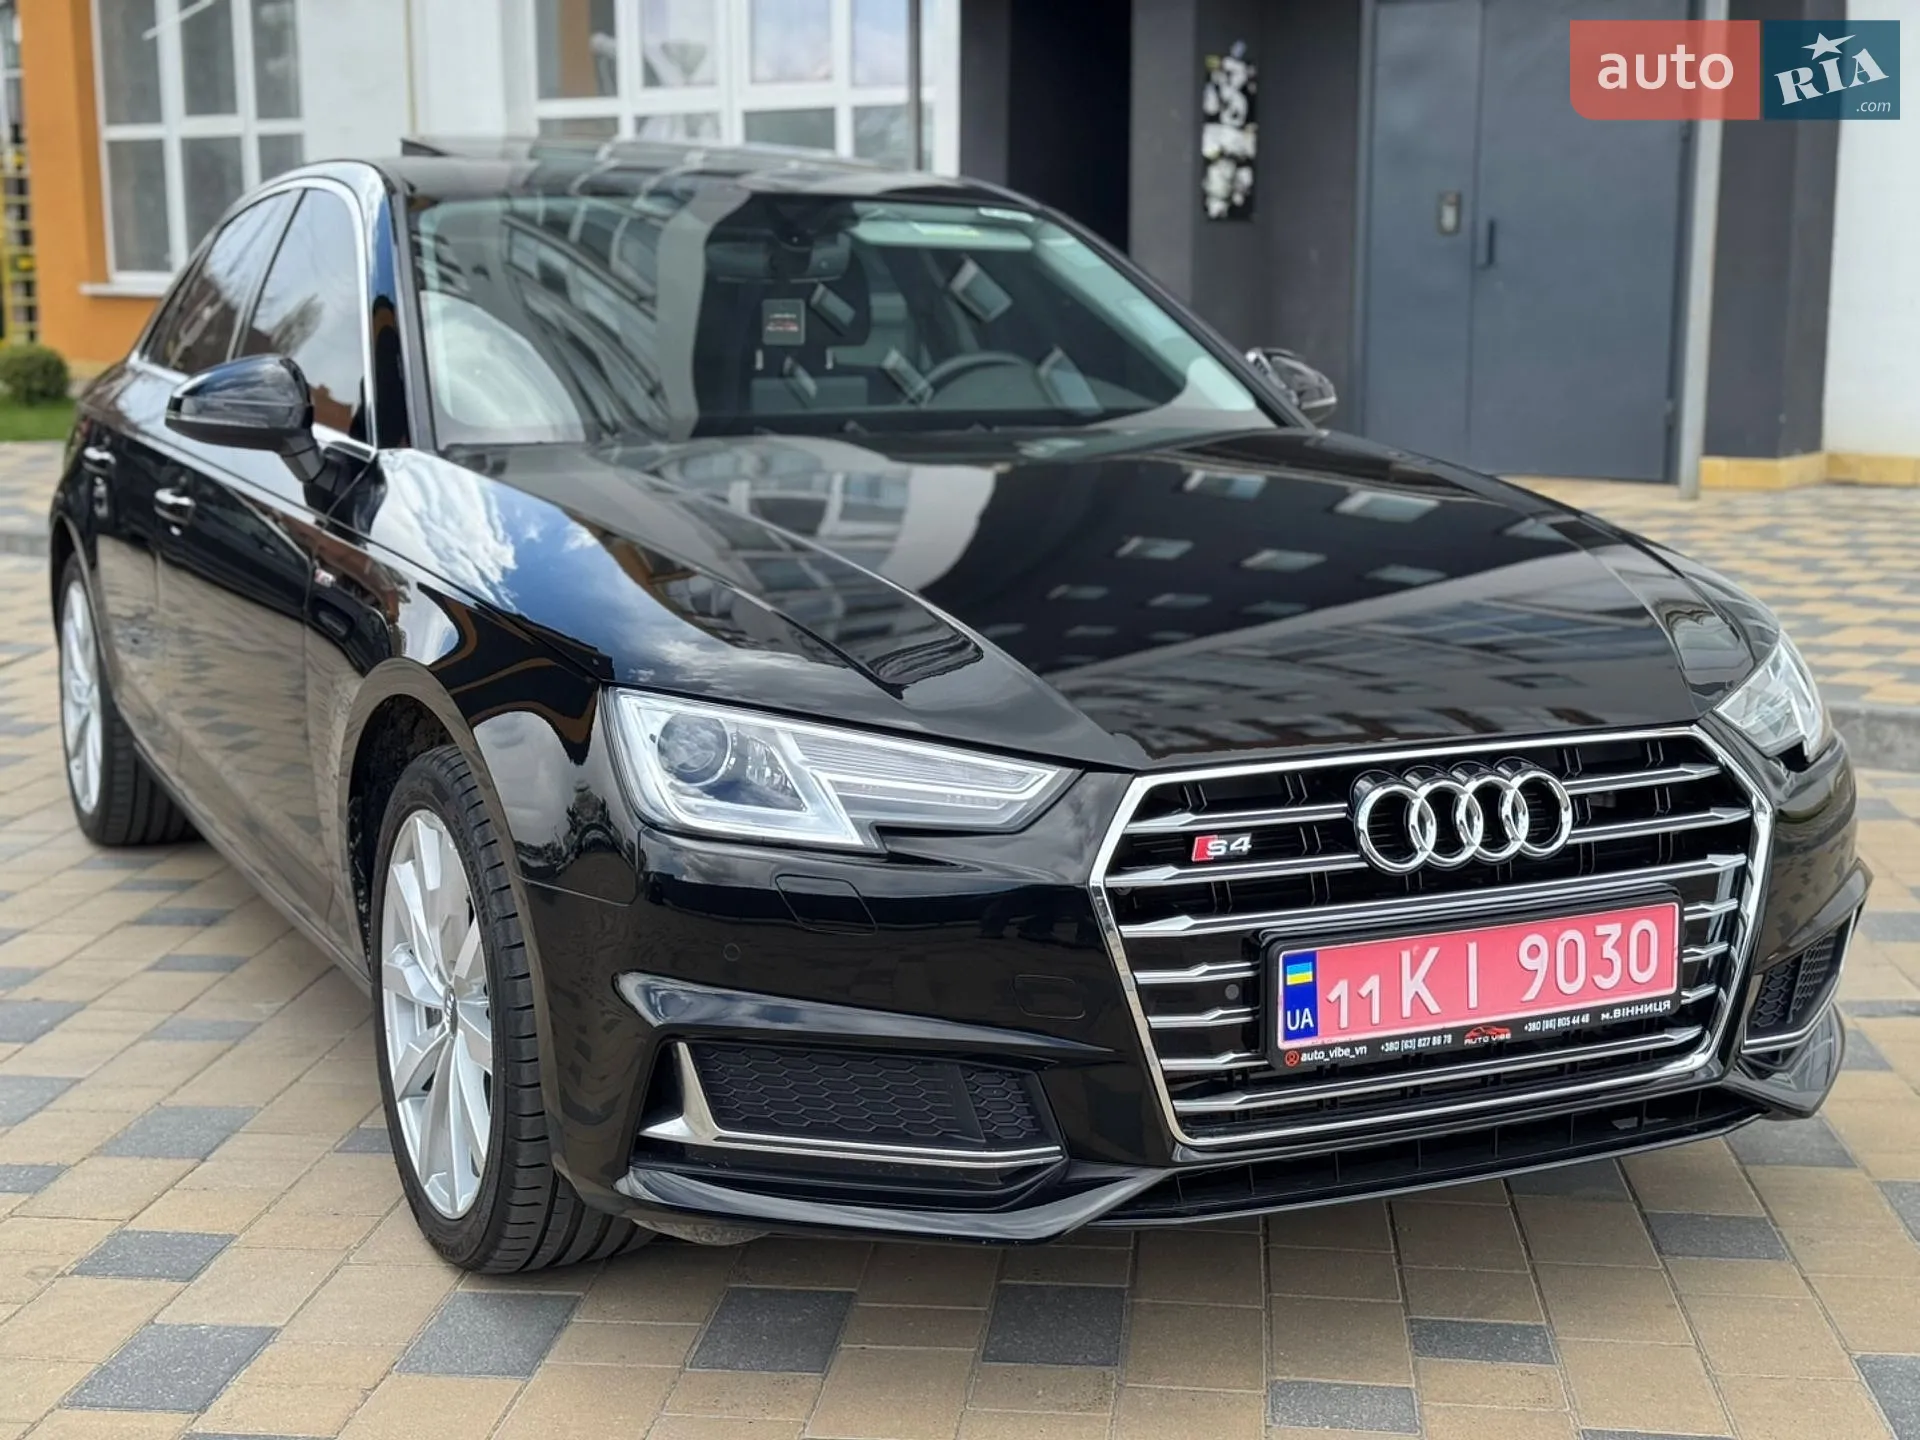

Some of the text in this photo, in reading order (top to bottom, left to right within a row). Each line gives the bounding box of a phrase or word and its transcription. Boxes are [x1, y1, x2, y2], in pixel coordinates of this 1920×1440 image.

[1207, 836, 1252, 856] S4
[1518, 918, 1658, 1002] 9030
[1286, 1007, 1315, 1031] UA
[1301, 1045, 1368, 1062] auto_vibe_vn
